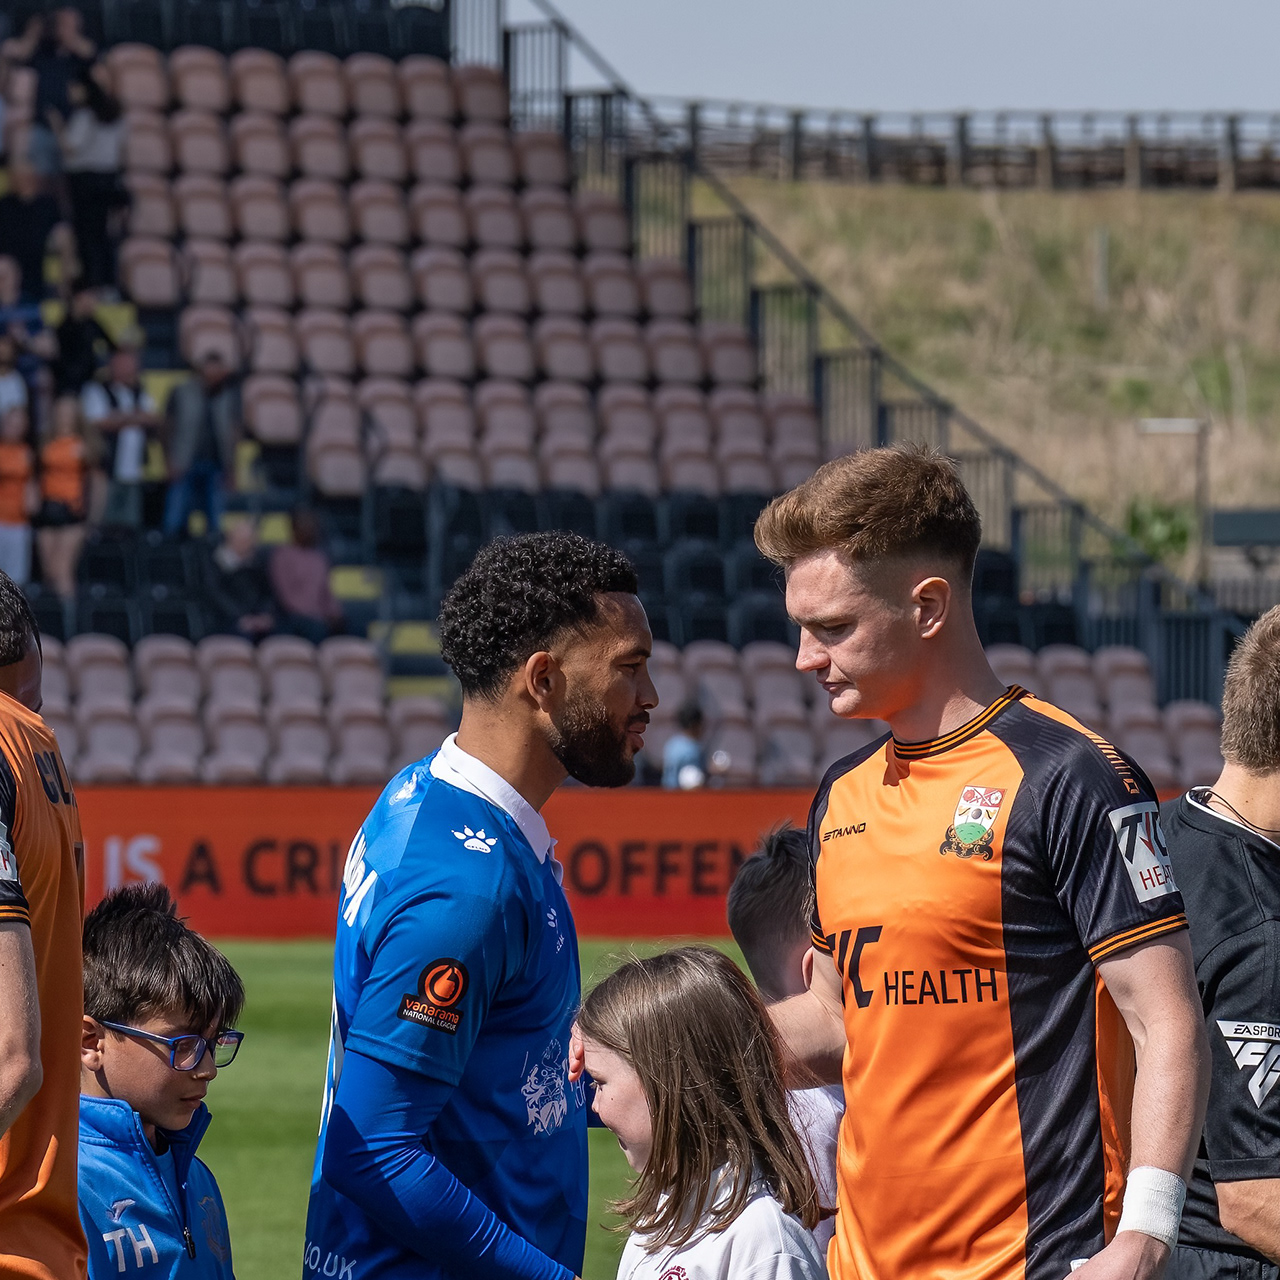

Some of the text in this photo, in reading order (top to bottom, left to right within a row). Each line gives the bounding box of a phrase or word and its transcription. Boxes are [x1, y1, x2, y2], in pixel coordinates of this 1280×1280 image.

[822, 822, 867, 842] STANNO
[105, 836, 164, 894] IS
[180, 841, 220, 895] A
[884, 967, 998, 1006] HEALTH
[402, 1009, 457, 1032] NATIONAL LEAGUE
[406, 999, 460, 1024] vanarama
[102, 1223, 159, 1273] TH
